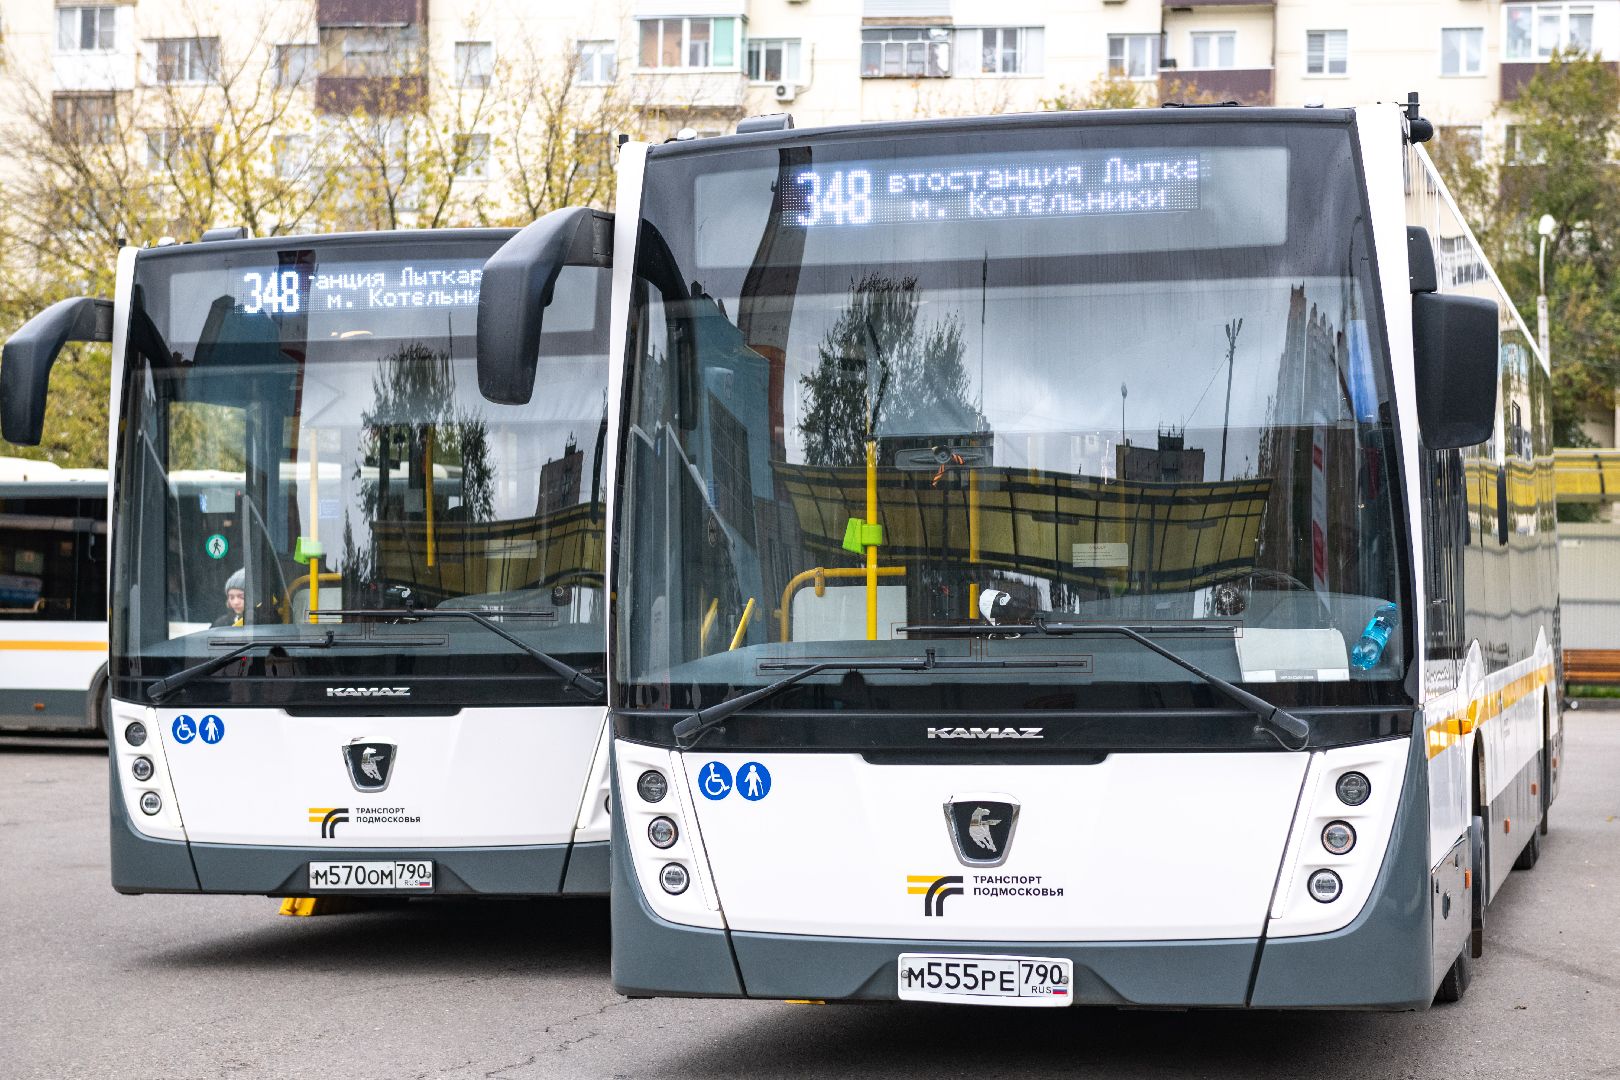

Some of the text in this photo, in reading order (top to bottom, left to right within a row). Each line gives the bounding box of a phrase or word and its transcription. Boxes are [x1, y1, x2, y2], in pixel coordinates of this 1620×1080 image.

[888, 166, 1081, 193] втостанция
[797, 169, 872, 226] 348
[911, 188, 1165, 218] м. Котельники
[308, 272, 385, 290] анция
[243, 271, 300, 314] 348
[327, 294, 353, 309] м.
[326, 687, 411, 697] KAMAZ
[927, 727, 1044, 739] KAMAZ
[356, 816, 421, 824] ПОДМОСКОВЬЯ
[396, 863, 427, 879] 790
[973, 875, 1043, 884] ТРАНСПОРТ
[973, 887, 1064, 897] ПОДМОСКОВЬЯ
[1021, 963, 1063, 985] 790
[1031, 985, 1052, 994] RUS
